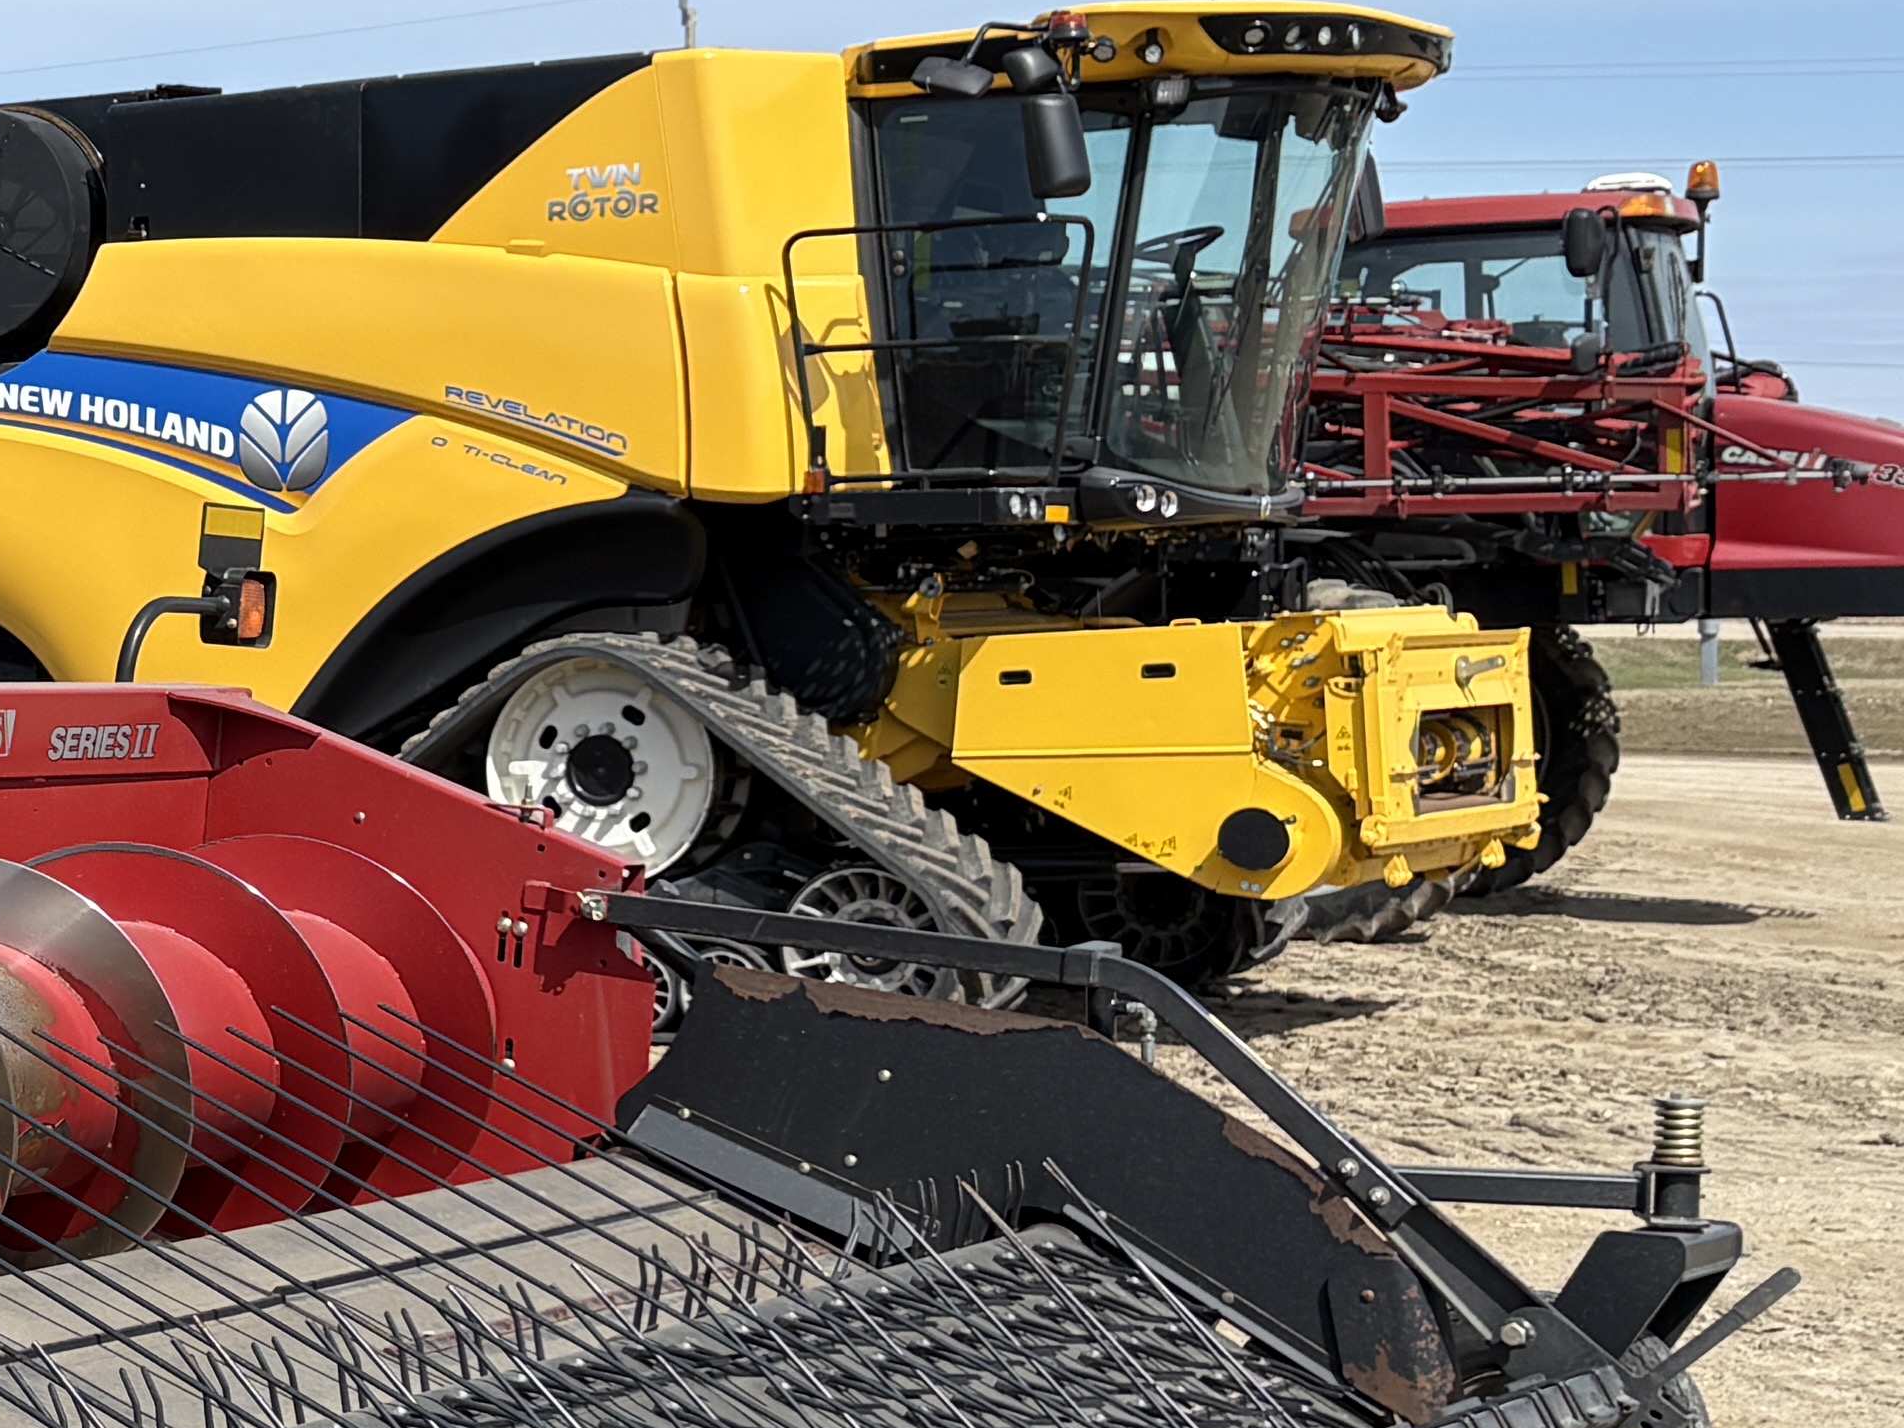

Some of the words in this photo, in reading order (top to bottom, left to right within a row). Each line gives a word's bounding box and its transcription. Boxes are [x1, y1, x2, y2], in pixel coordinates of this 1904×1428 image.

[566, 162, 640, 190] TWIN
[548, 188, 659, 222] ROTOR
[80, 393, 235, 459] HOLLAND
[445, 385, 628, 451] REVELATION
[48, 724, 133, 761] SERIES
[130, 723, 160, 759] II
